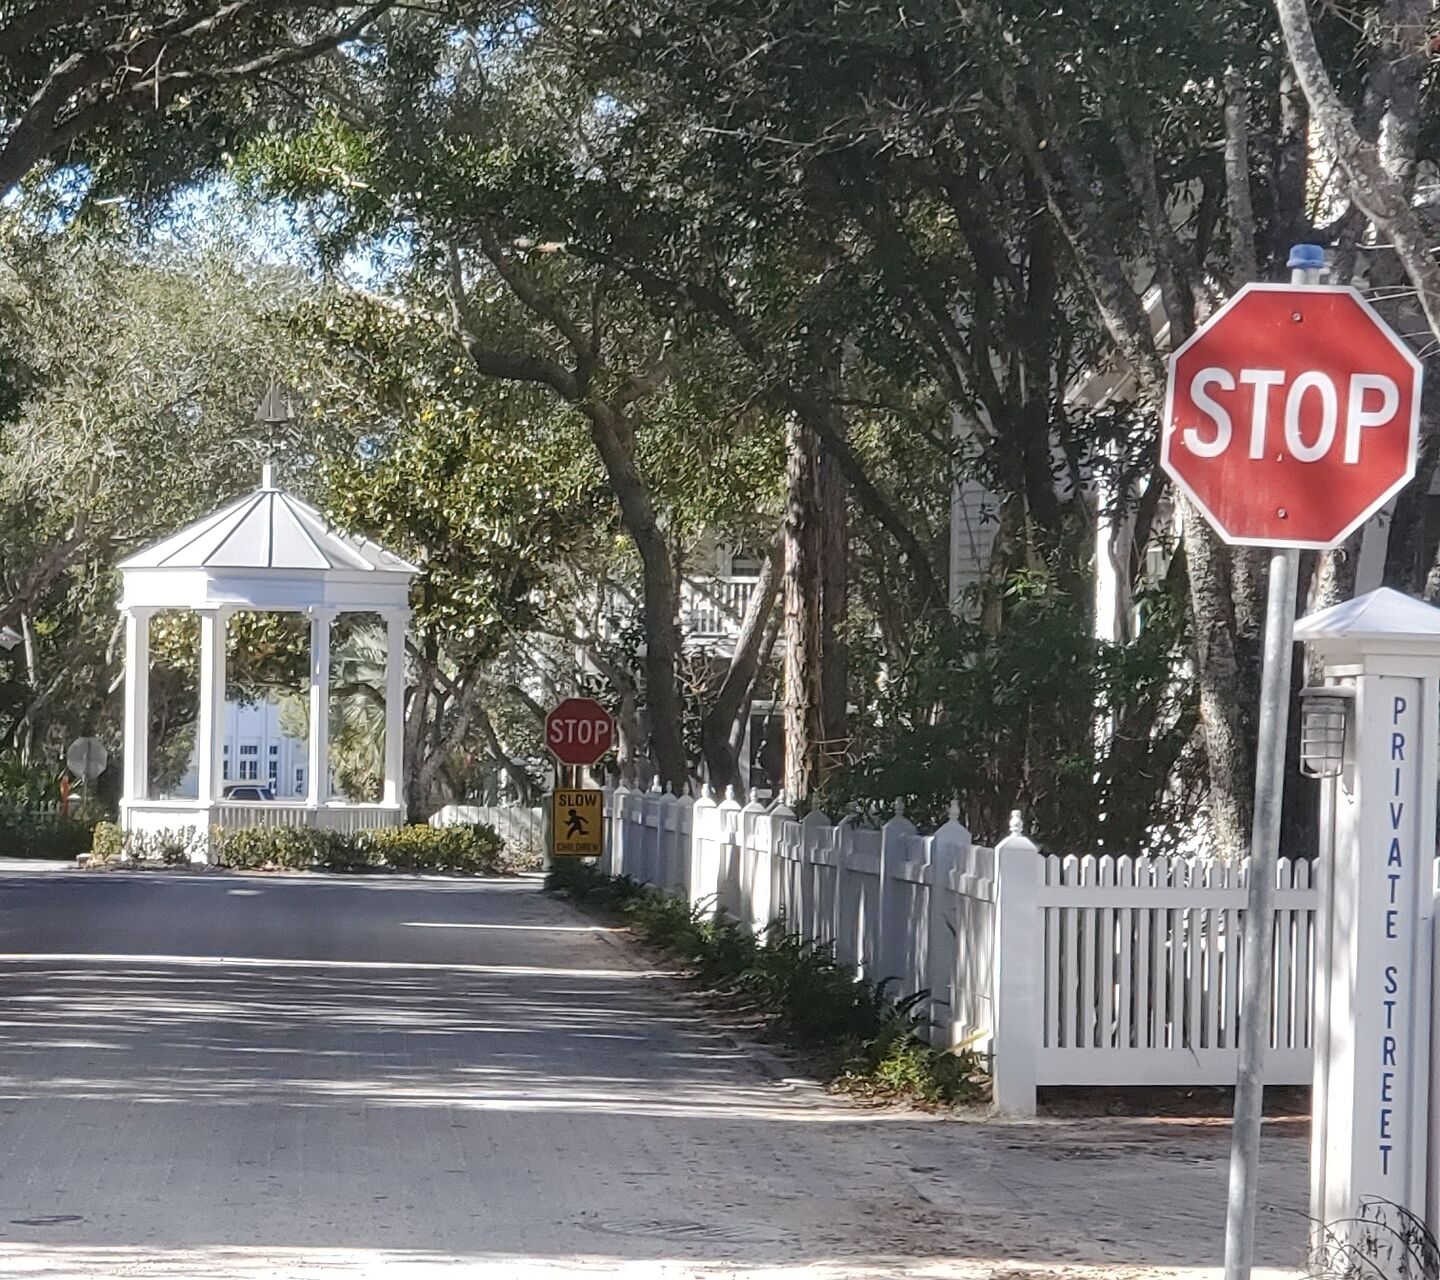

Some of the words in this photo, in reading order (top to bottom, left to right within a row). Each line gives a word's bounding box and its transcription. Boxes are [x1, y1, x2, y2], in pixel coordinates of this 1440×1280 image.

[1182, 367, 1400, 464] STOP
[549, 718, 609, 746] STOP
[558, 793, 597, 808] SLOW
[1385, 696, 1407, 939] PRIVATE
[1379, 966, 1398, 1175] STREET
